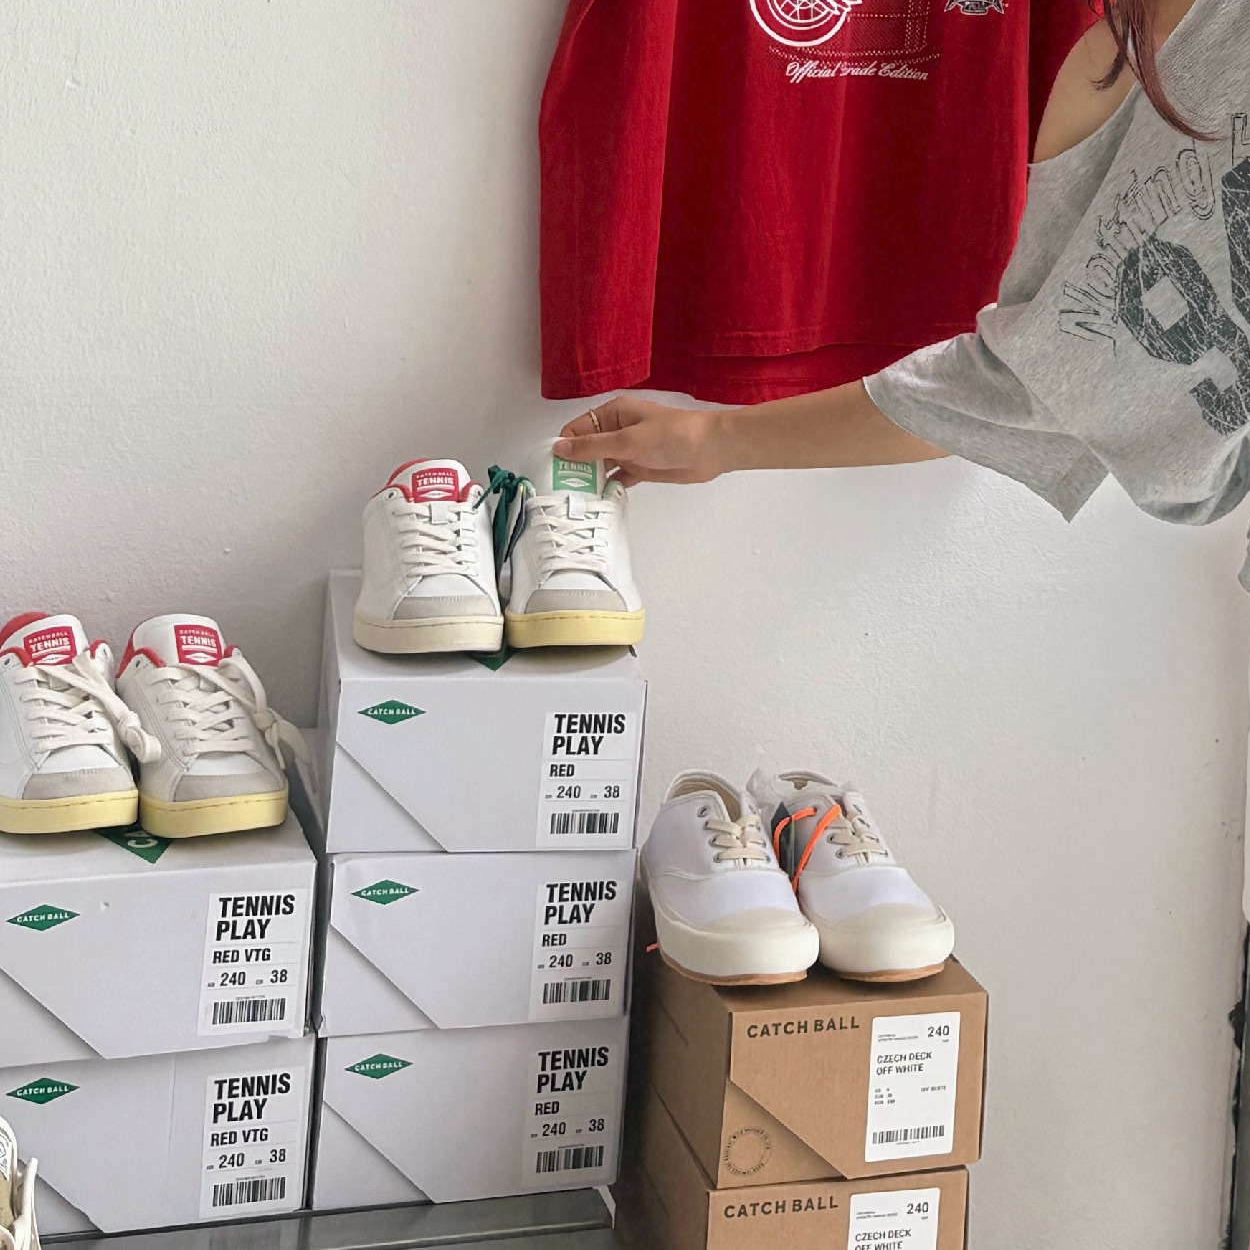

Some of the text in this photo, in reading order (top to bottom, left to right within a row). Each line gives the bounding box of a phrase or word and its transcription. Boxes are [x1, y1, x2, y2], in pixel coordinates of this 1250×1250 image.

[785, 60, 841, 84] Official
[878, 62, 929, 81] Edition
[30, 637, 70, 652] TENNIS
[181, 635, 217, 648] TENNIS
[396, 707, 416, 715] BALL
[554, 713, 626, 734] TENNIS
[552, 735, 604, 755] PLAY
[549, 763, 575, 777] RED
[557, 785, 581, 799] 240
[603, 785, 620, 798] 38
[361, 889, 388, 897] CATCH
[546, 881, 617, 903] TENNIS
[219, 894, 295, 918] TENNIS
[544, 903, 595, 925] PLAY
[16, 912, 69, 923] CATCH BALL
[215, 918, 271, 941] PLAY
[542, 933, 567, 947] RED
[212, 948, 271, 964] RED VTG
[549, 952, 612, 968] 240 38
[220, 971, 246, 986] 240
[270, 969, 288, 983] 38
[746, 1016, 860, 1039] CATCH BALL
[927, 1025, 950, 1038] 240
[538, 1046, 609, 1071] TENNIS
[877, 1051, 933, 1064] CZECH DECK
[354, 1062, 381, 1071] CATCH
[876, 1063, 924, 1076] OFF WHITE
[214, 1072, 291, 1100] TENNIS
[536, 1070, 588, 1093] PLAY
[16, 1085, 68, 1097] CATCH BALL
[212, 1097, 268, 1124] PLAY
[534, 1101, 560, 1116] RED
[542, 1118, 605, 1137] 240 38
[210, 1127, 269, 1147] RED VTG
[219, 1148, 286, 1169] 240 38
[723, 1196, 839, 1218] CATCH BALL
[906, 1202, 929, 1215] 240
[854, 1229, 912, 1242] CZECH DECK
